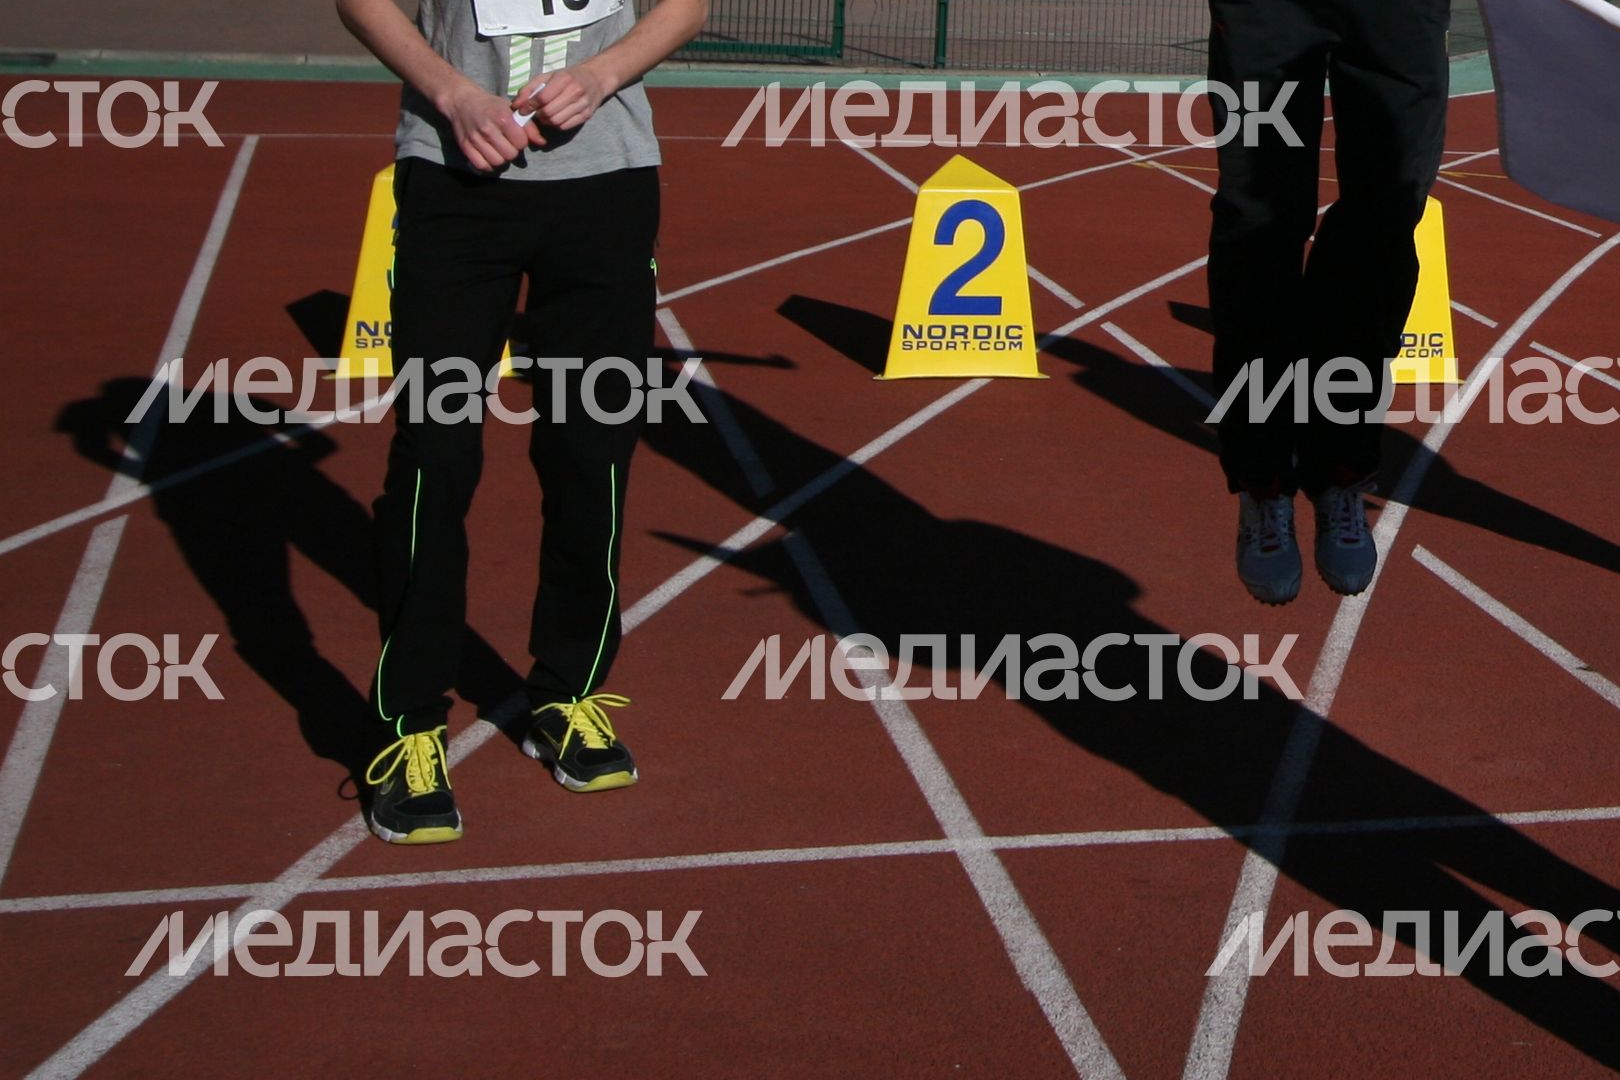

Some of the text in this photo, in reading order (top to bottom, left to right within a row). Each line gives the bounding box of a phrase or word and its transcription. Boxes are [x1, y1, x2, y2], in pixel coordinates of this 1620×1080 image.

[928, 199, 1005, 316] 2
[902, 324, 1023, 340] NORDIC
[902, 340, 1023, 351] SPORT.COM
[1401, 333, 1444, 348] DIC
